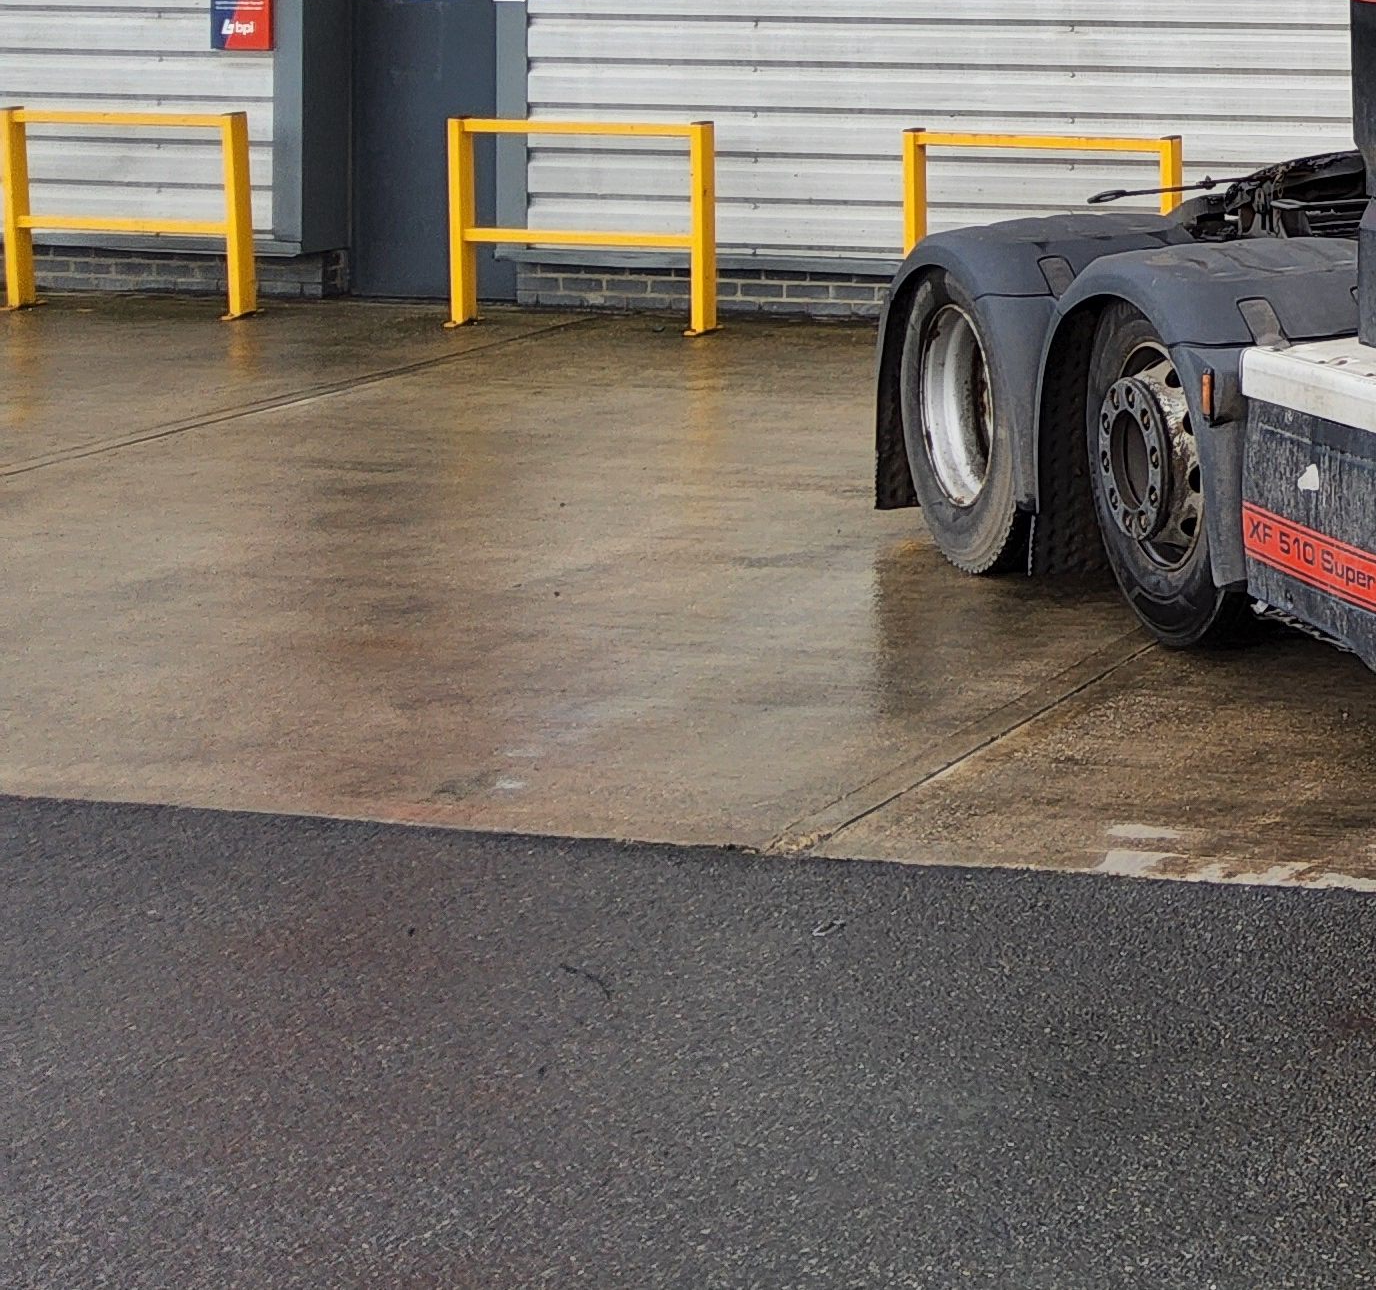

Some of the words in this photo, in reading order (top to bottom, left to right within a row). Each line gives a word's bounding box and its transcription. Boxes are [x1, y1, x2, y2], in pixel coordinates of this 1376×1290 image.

[1249, 518, 1274, 544] XF
[1278, 530, 1315, 567] 510
[1320, 547, 1376, 592] Super
